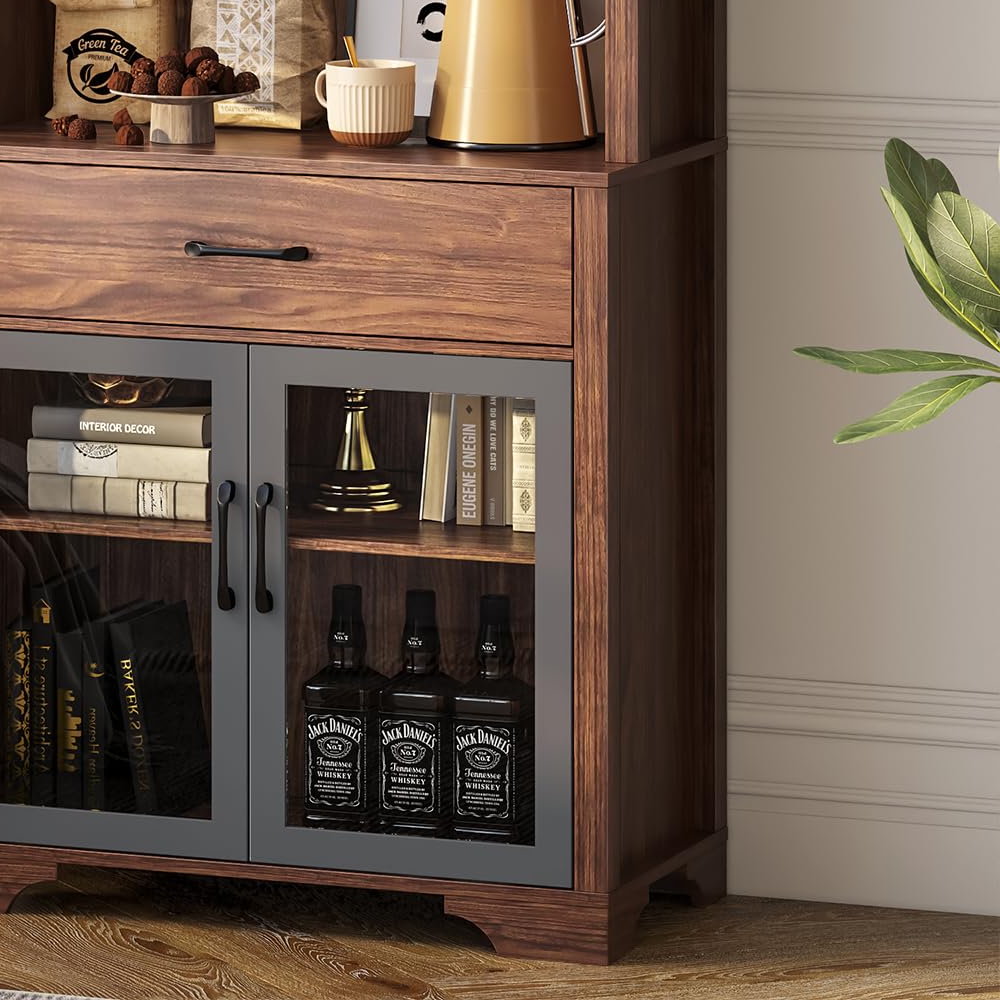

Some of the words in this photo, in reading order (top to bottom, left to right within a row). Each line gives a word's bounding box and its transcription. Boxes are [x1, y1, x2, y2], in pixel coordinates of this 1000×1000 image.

[78, 38, 106, 51] Green
[110, 38, 129, 56] Tea
[489, 407, 497, 418] DO
[80, 421, 123, 433] INTERIOR
[124, 424, 156, 435] DECOR
[489, 419, 497, 432] WE
[462, 423, 477, 469] ONEGIN
[489, 432, 497, 452] LOVE
[489, 453, 497, 471] CATS
[462, 471, 477, 519] EUGENE
[308, 721, 329, 740] JACK
[329, 718, 363, 744] DANIEL'S
[382, 727, 402, 746] JACK
[403, 723, 437, 749] DANIEL'S
[456, 732, 477, 751] JACK
[477, 728, 512, 754] DANIEL'S
[316, 756, 352, 768] Tennessee
[390, 762, 427, 774] Tennessee
[317, 771, 352, 780] WHISKEY
[390, 776, 426, 785] WHISKEY
[464, 768, 501, 779] Tennessee
[465, 782, 501, 791] WHISKEY
